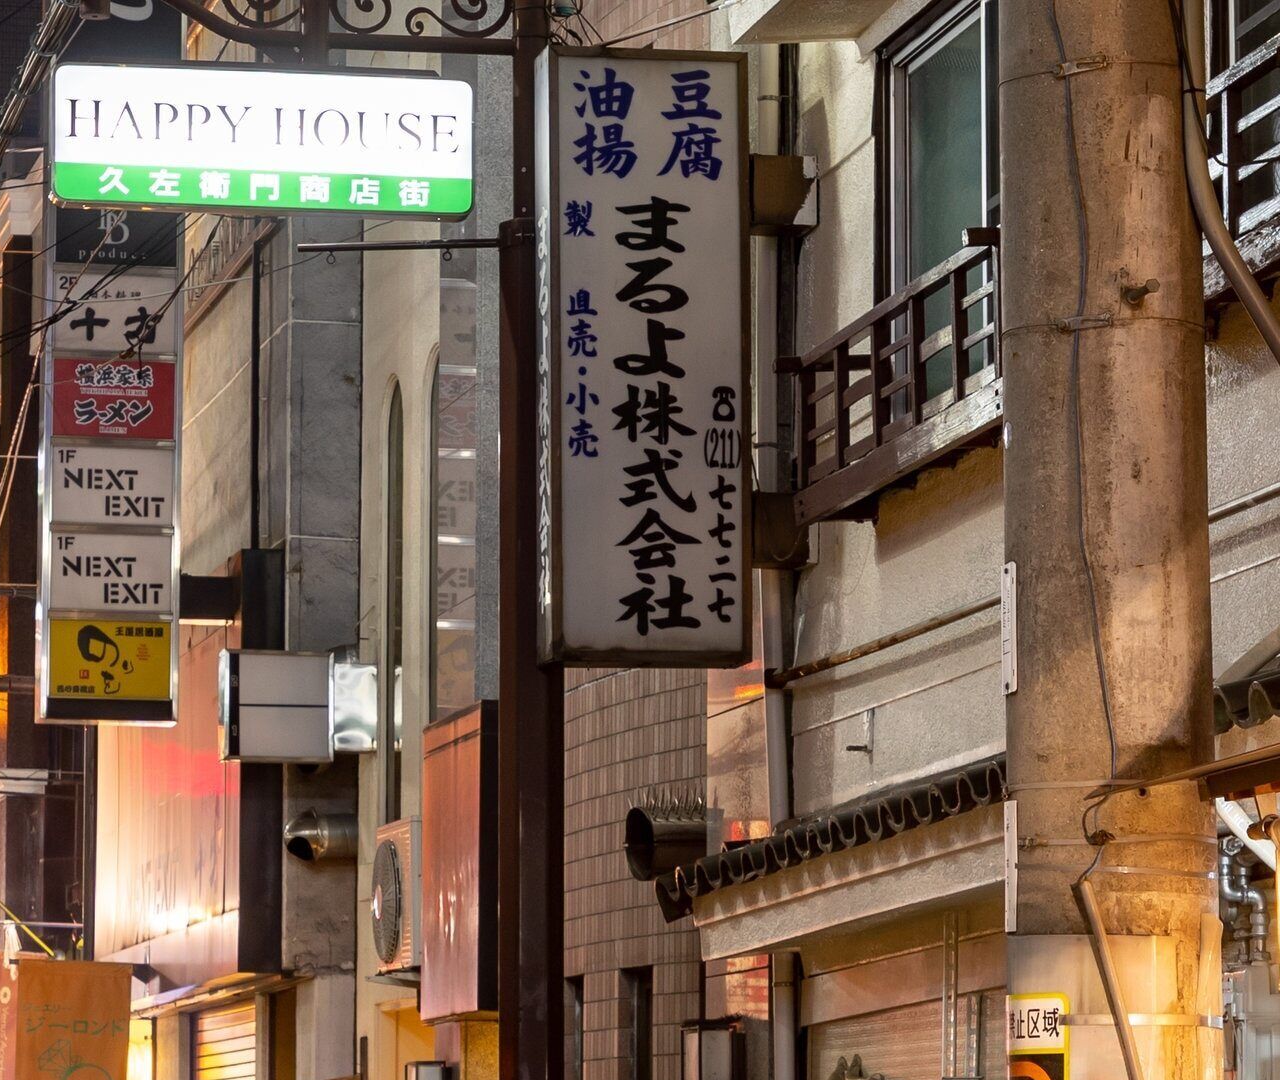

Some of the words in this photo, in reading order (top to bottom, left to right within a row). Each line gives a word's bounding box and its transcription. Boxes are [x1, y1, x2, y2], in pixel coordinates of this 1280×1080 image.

[65, 98, 252, 143] HAPPY
[275, 107, 460, 154] HOUSE
[572, 69, 638, 178] 油揚
[657, 69, 723, 182] 豆腐
[98, 166, 431, 208] 久左衛門商店街
[74, 398, 153, 427] ラーメン
[612, 195, 702, 637] まるよ株式会社
[58, 450, 76, 463] 1F
[64, 468, 138, 490] NEXT
[105, 496, 164, 518] EXIT
[57, 536, 75, 550] 1F
[63, 556, 137, 577] NEXT
[104, 583, 163, 604] EXIT
